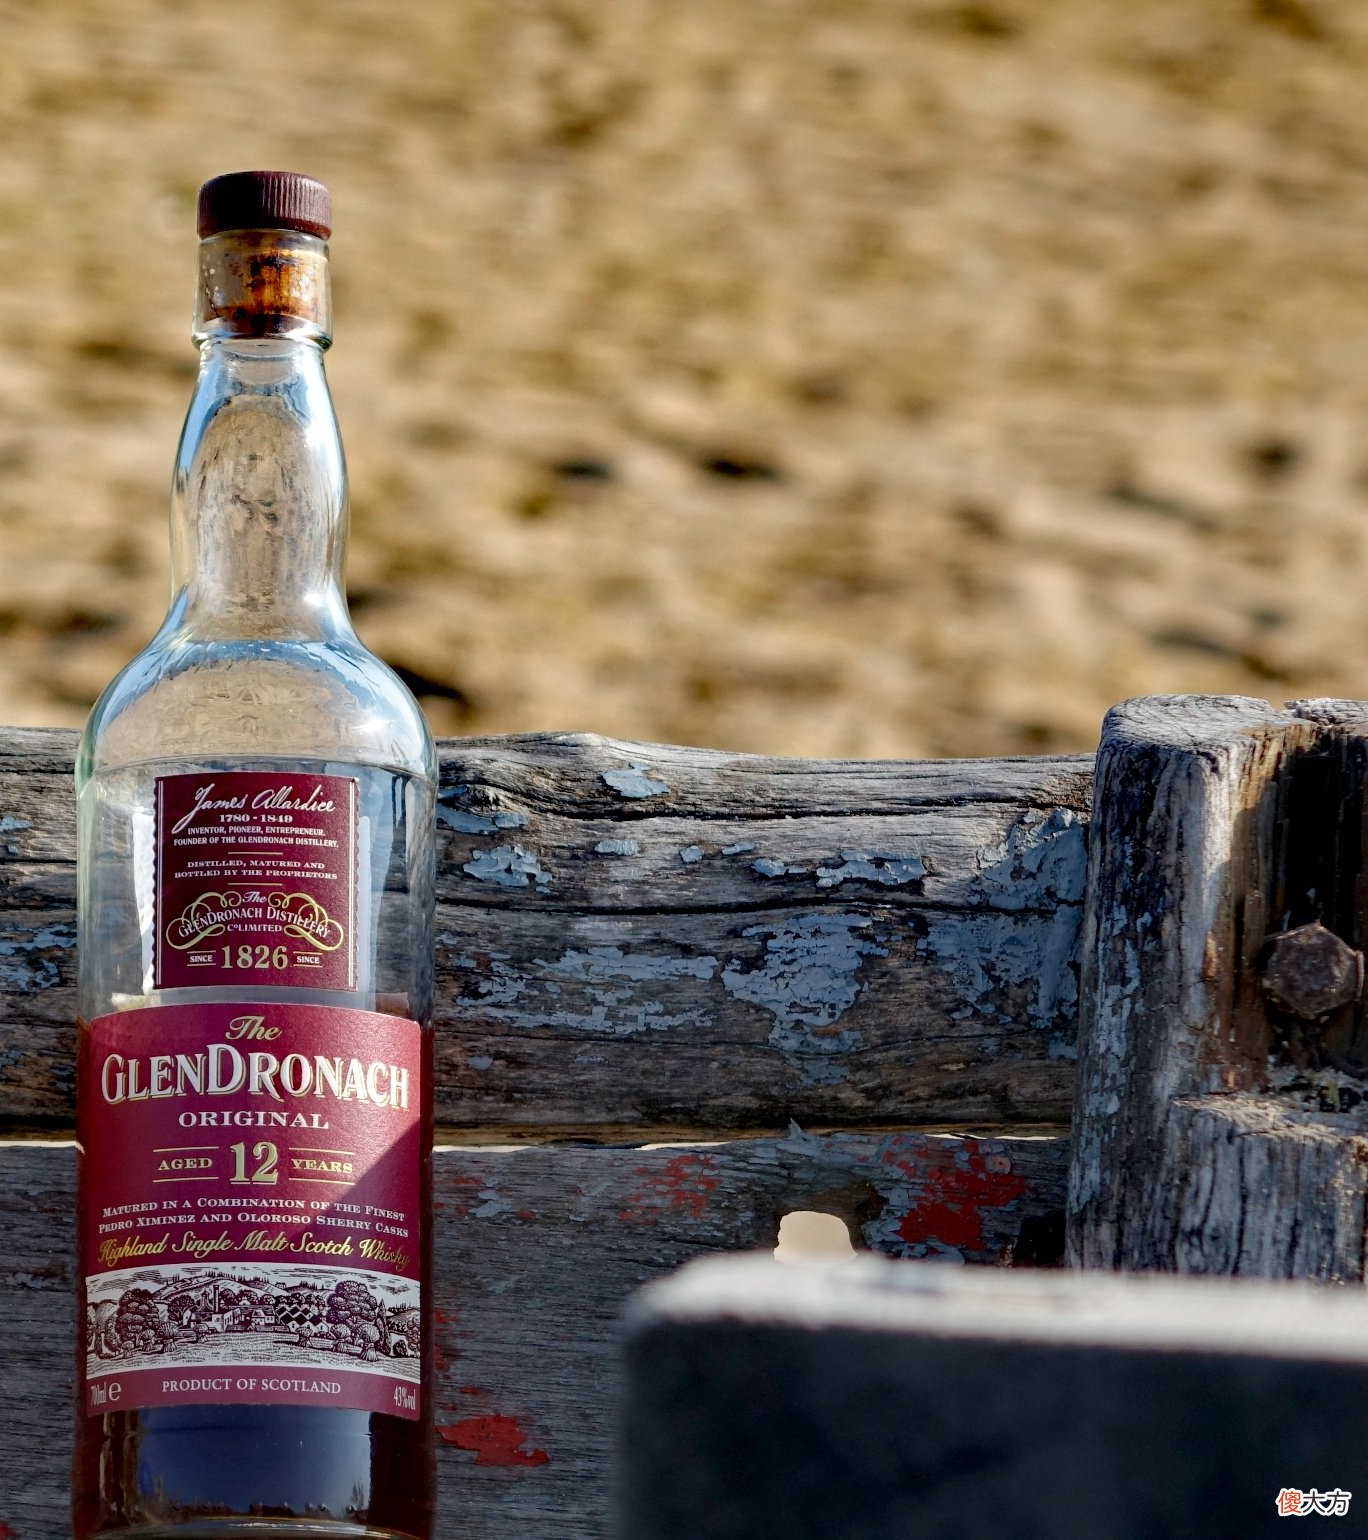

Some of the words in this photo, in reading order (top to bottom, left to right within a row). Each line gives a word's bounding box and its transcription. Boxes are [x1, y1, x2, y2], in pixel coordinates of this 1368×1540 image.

[172, 783, 248, 835] James
[251, 784, 336, 812] Allardice
[219, 814, 251, 823] 1780
[260, 814, 293, 823] 1849
[187, 826, 227, 835] INVENTOR,
[228, 826, 264, 834] PIONEER,
[265, 826, 326, 836] ENTREPRENEUR.
[173, 837, 208, 846] FOUNDER
[221, 836, 236, 844] THE
[237, 836, 293, 844] GLENDRONACH
[295, 838, 339, 848] DISTILLERY.
[187, 860, 247, 868] DISTILLED,
[249, 860, 301, 868] MATURED
[174, 870, 221, 879] BOTTLED
[265, 870, 338, 880] PROPRIETORS
[242, 891, 267, 904] The
[178, 907, 263, 938] GLENDRONACH
[266, 906, 332, 938] DISTILLERY
[189, 954, 213, 963] SINCE
[221, 945, 289, 970] 1826
[296, 955, 320, 964] SINCE
[225, 1015, 282, 1041] The
[101, 1043, 410, 1110] GLENDRONACH
[178, 1111, 330, 1130] ORIGINAL
[157, 1157, 214, 1171] AGED
[229, 1141, 279, 1185] 12
[291, 1158, 354, 1174] YEARS
[102, 1202, 158, 1218] MATURED
[161, 1200, 178, 1210] IN
[182, 1199, 192, 1208] A
[197, 1197, 306, 1208] COMBINATION
[310, 1201, 330, 1211] OF
[334, 1202, 361, 1214] THE
[364, 1205, 405, 1222] FINEST
[98, 1220, 133, 1234] PEDRO
[136, 1214, 196, 1228] XIMINEZ
[200, 1213, 232, 1223] AND
[237, 1212, 311, 1224] OLOROSO
[316, 1215, 372, 1231] SHERRY
[375, 1222, 409, 1238] CASKS
[97, 1232, 170, 1268] Highland
[172, 1230, 234, 1259] Single
[234, 1229, 290, 1251] Malt
[289, 1231, 354, 1256] Scotch
[359, 1237, 410, 1273] Whisky
[162, 1379, 233, 1393] PRODUCT
[236, 1378, 257, 1391] OF
[260, 1378, 342, 1395] SCOTLAND
